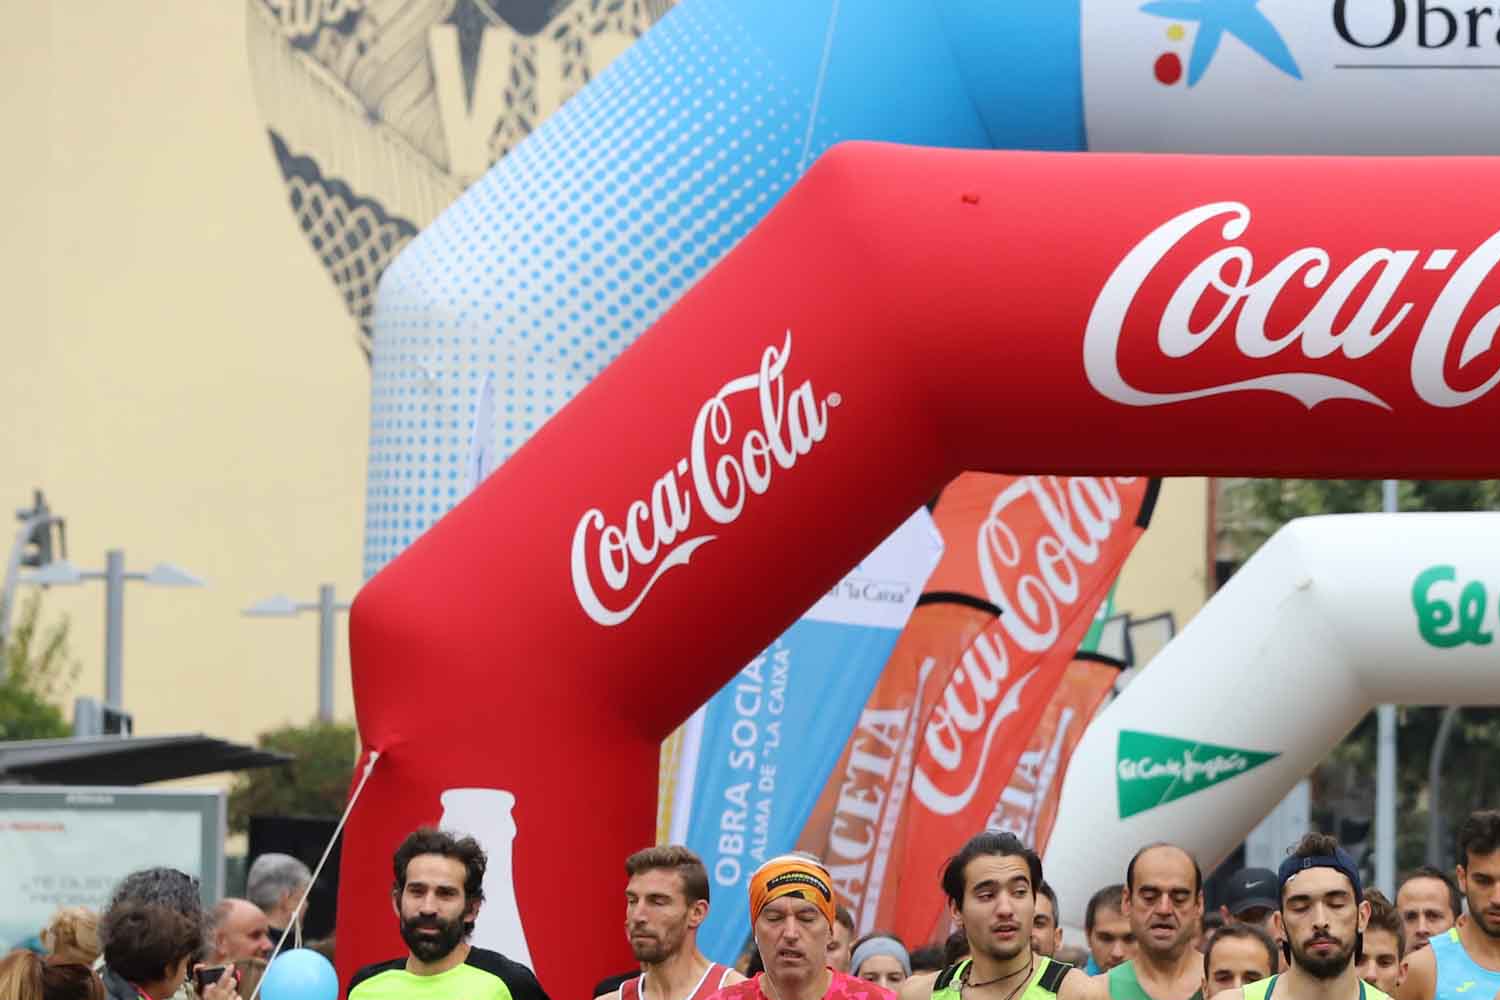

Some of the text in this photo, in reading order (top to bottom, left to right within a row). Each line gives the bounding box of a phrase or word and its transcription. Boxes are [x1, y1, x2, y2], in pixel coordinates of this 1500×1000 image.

[571, 329, 828, 626] Coca-Cola
[1411, 564, 1493, 648] El
[758, 763, 777, 792] DE
[828, 707, 909, 906] ACETA
[714, 782, 752, 887] OBRA
[750, 796, 772, 862] ALMA
